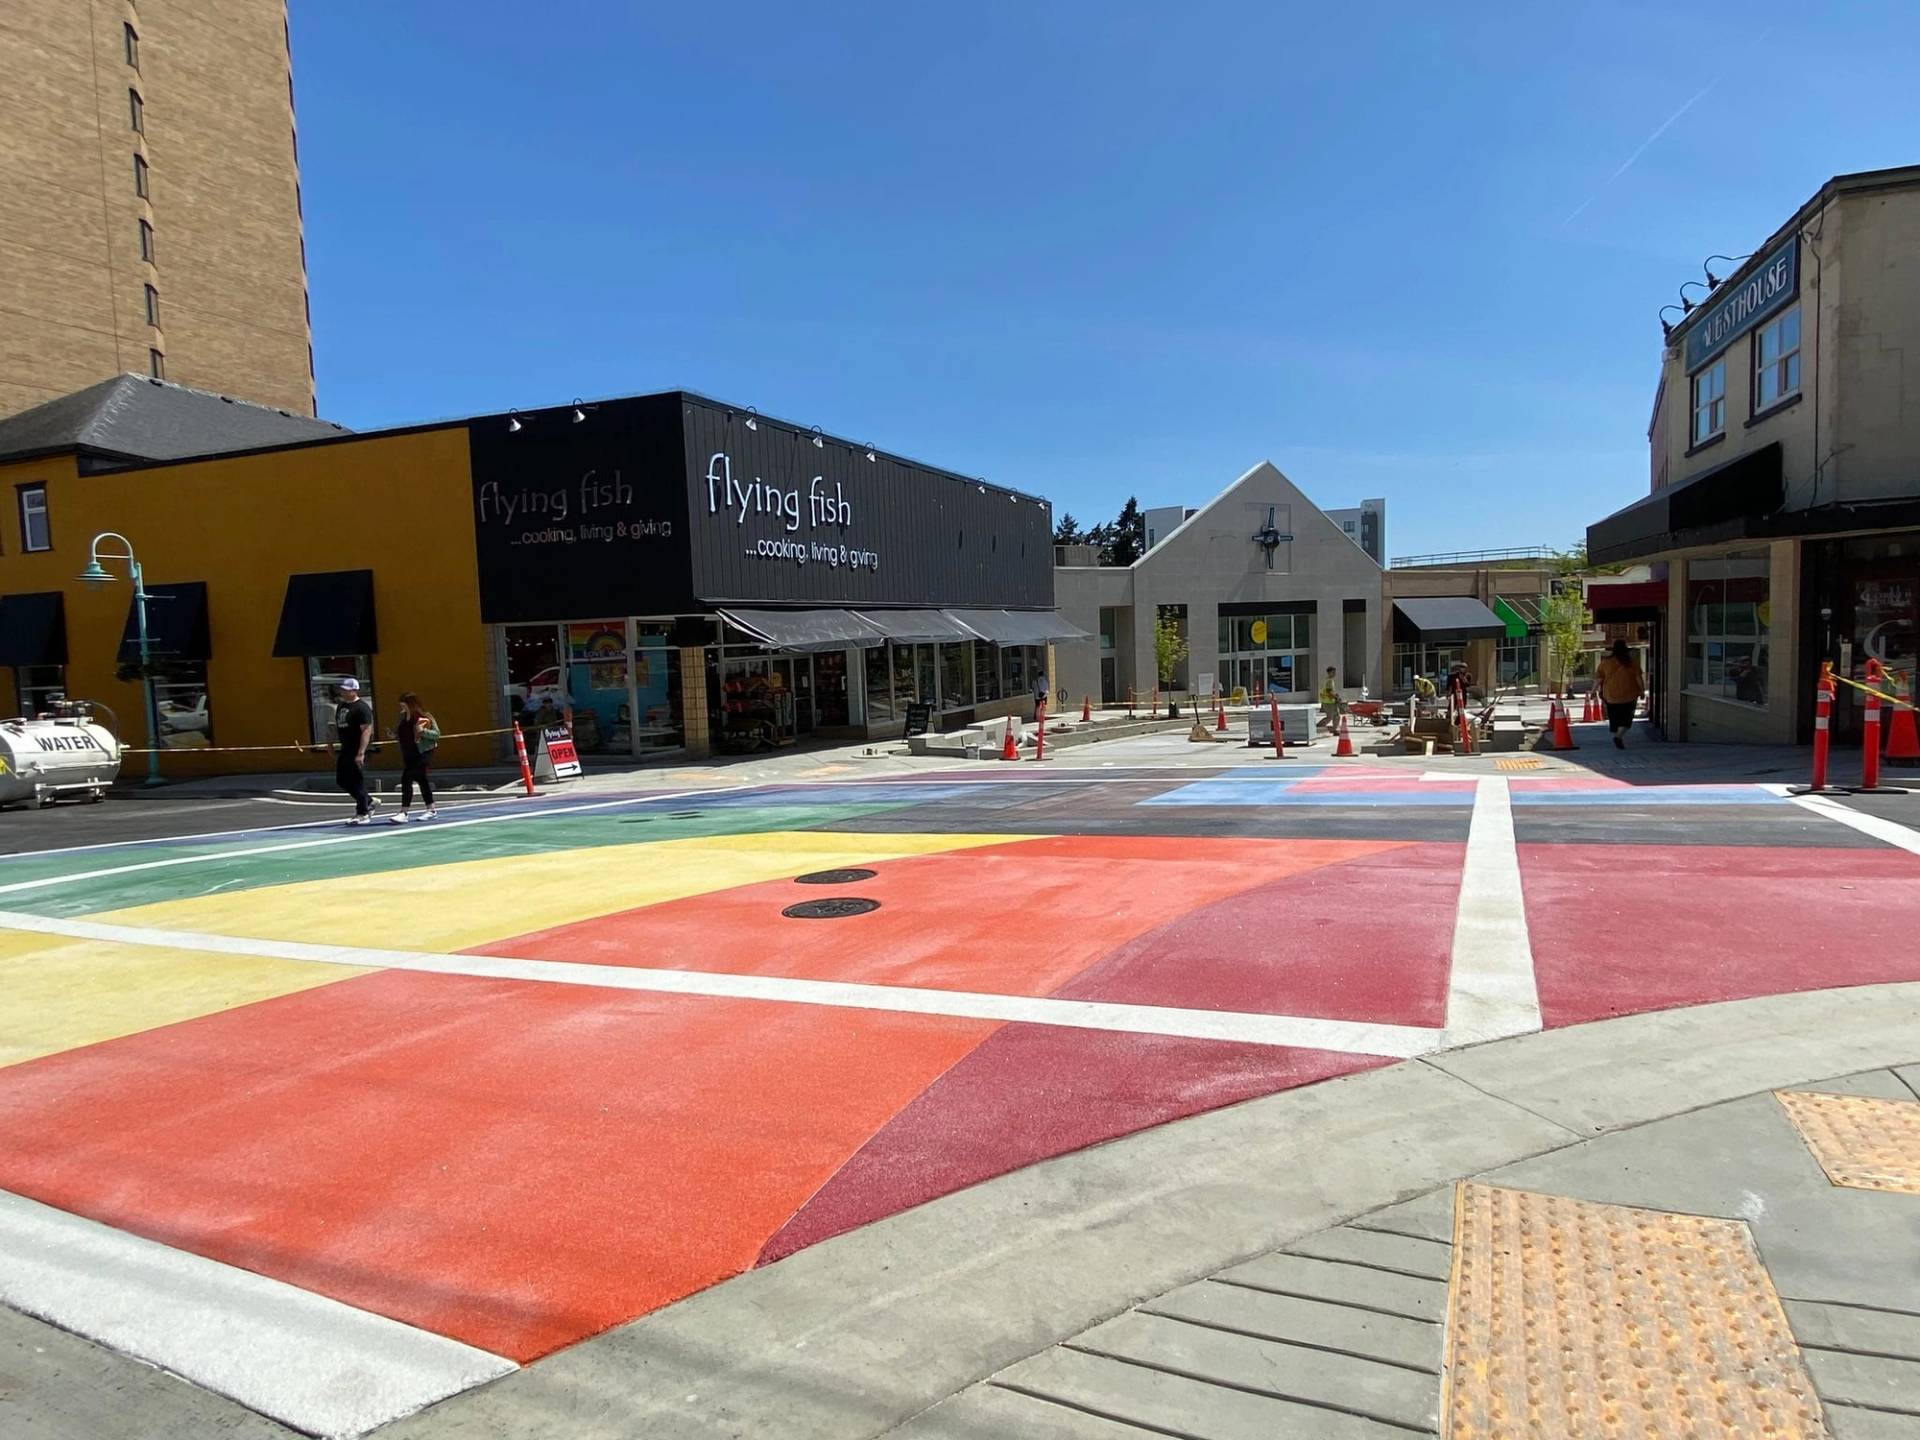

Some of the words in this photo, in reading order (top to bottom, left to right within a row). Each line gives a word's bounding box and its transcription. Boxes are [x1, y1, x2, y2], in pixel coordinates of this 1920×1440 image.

[1703, 257, 1787, 348] WESTHOUSE
[479, 481, 567, 525] flying
[579, 469, 633, 514] fish
[705, 452, 800, 531] flying
[809, 476, 851, 527] fish
[580, 523, 614, 543] living
[616, 521, 628, 537] &
[630, 518, 672, 540] giving
[811, 541, 838, 567] living
[839, 545, 847, 564] &
[850, 548, 878, 570] giving
[35, 735, 96, 752] WATER
[551, 747, 575, 760] OPEN
